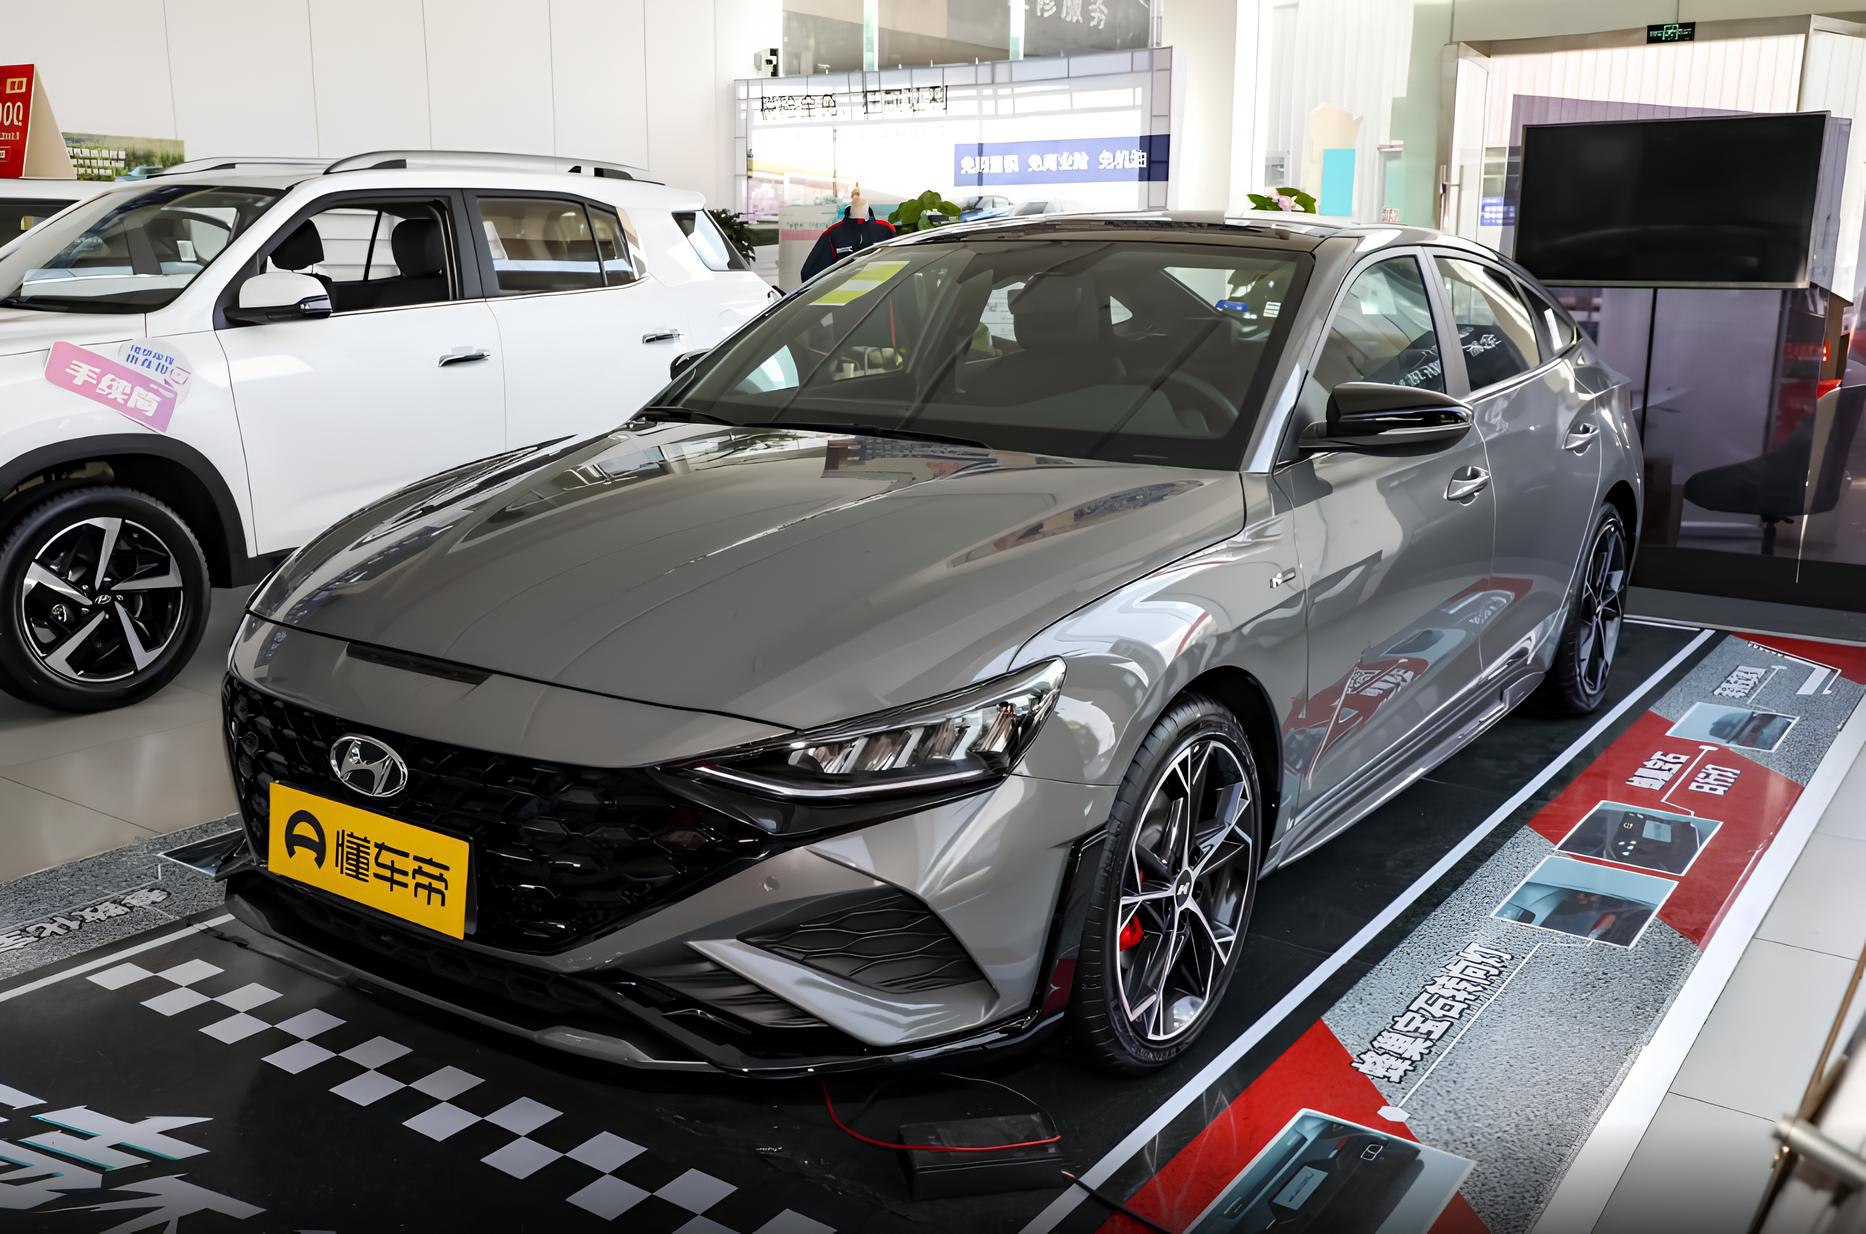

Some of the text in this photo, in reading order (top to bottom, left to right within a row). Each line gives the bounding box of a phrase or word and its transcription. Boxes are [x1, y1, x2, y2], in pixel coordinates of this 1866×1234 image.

[335, 829, 451, 907] 懂车帝
[1350, 942, 1512, 1084] 蜂巢宝石转向灯
